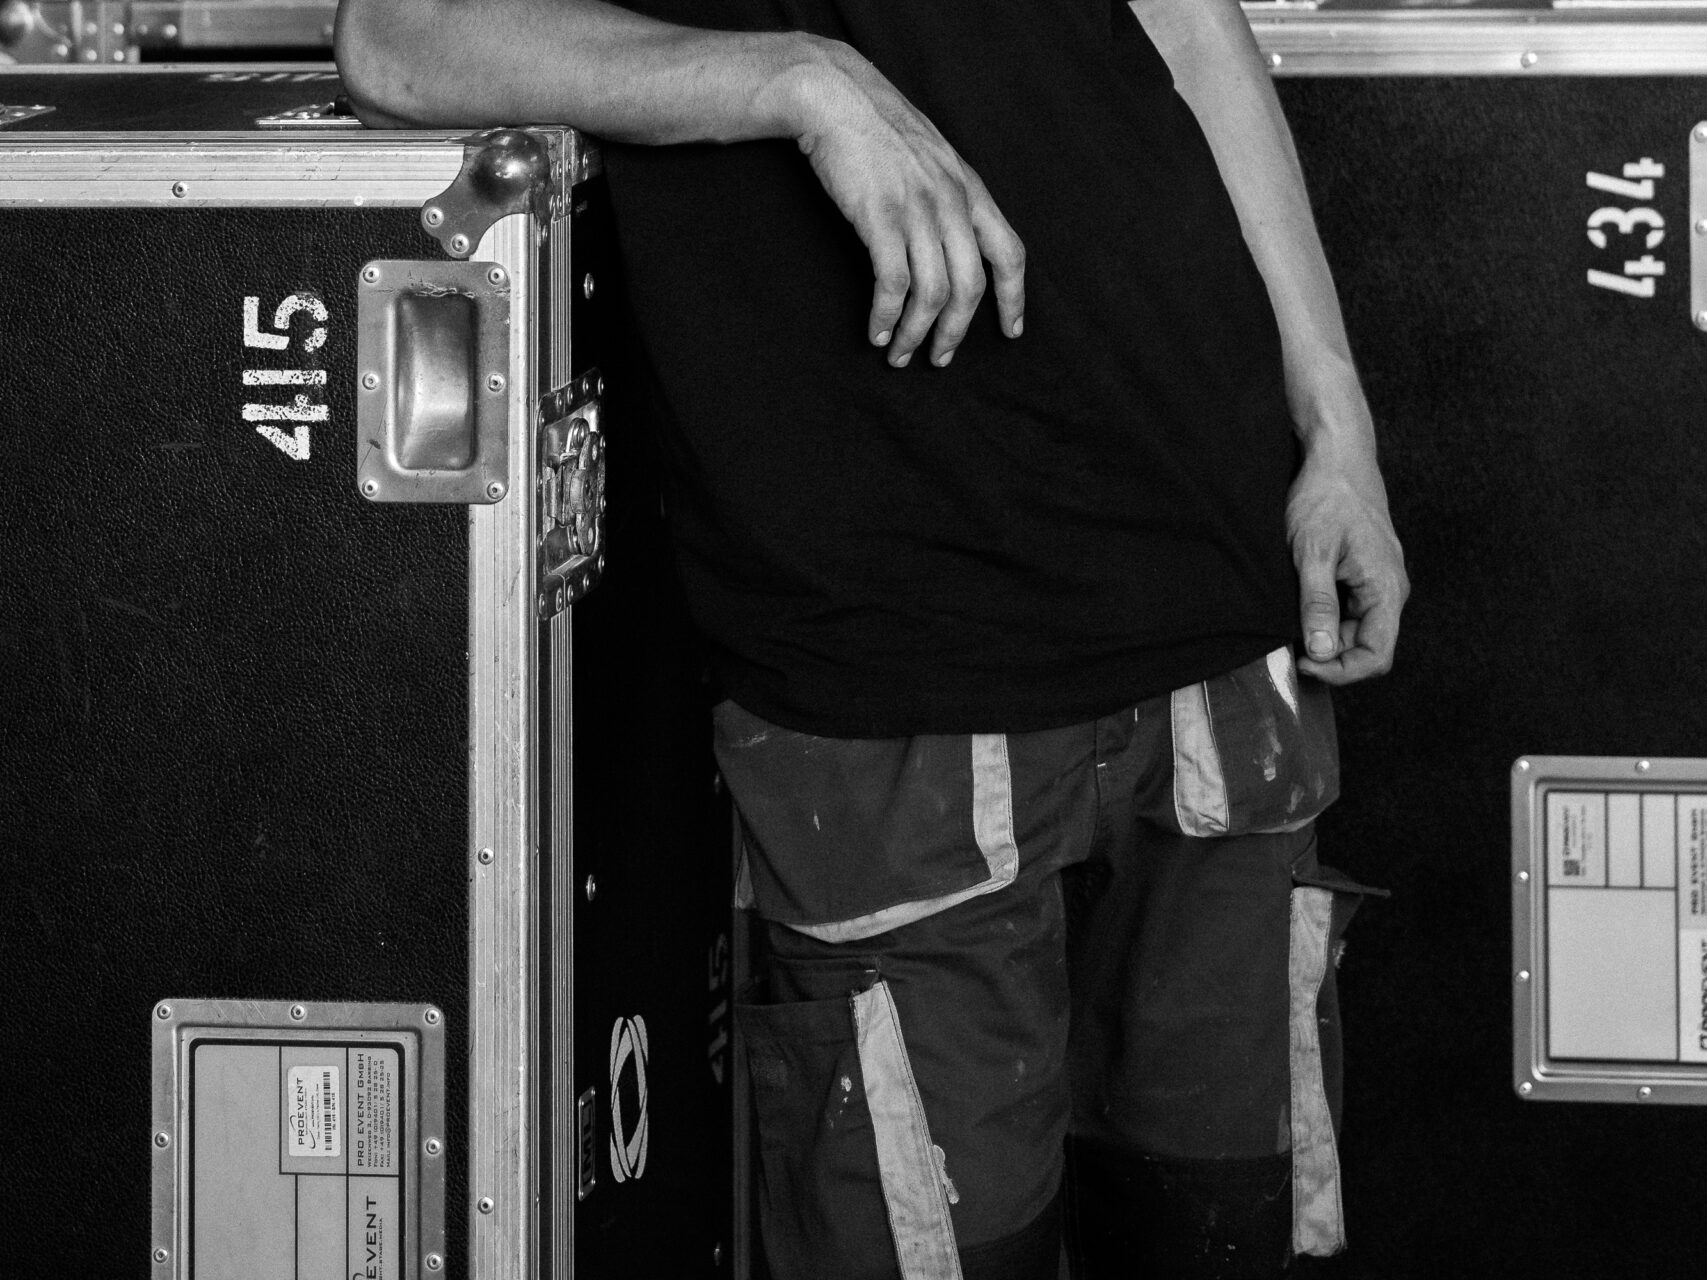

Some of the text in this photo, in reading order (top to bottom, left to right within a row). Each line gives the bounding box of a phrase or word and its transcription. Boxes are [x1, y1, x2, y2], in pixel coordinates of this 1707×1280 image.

[1586, 157, 1665, 297] 434
[242, 293, 329, 461] 415
[708, 934, 727, 1084] 415
[296, 1077, 305, 1145] PROEVENT
[366, 1195, 376, 1279] EVENT
